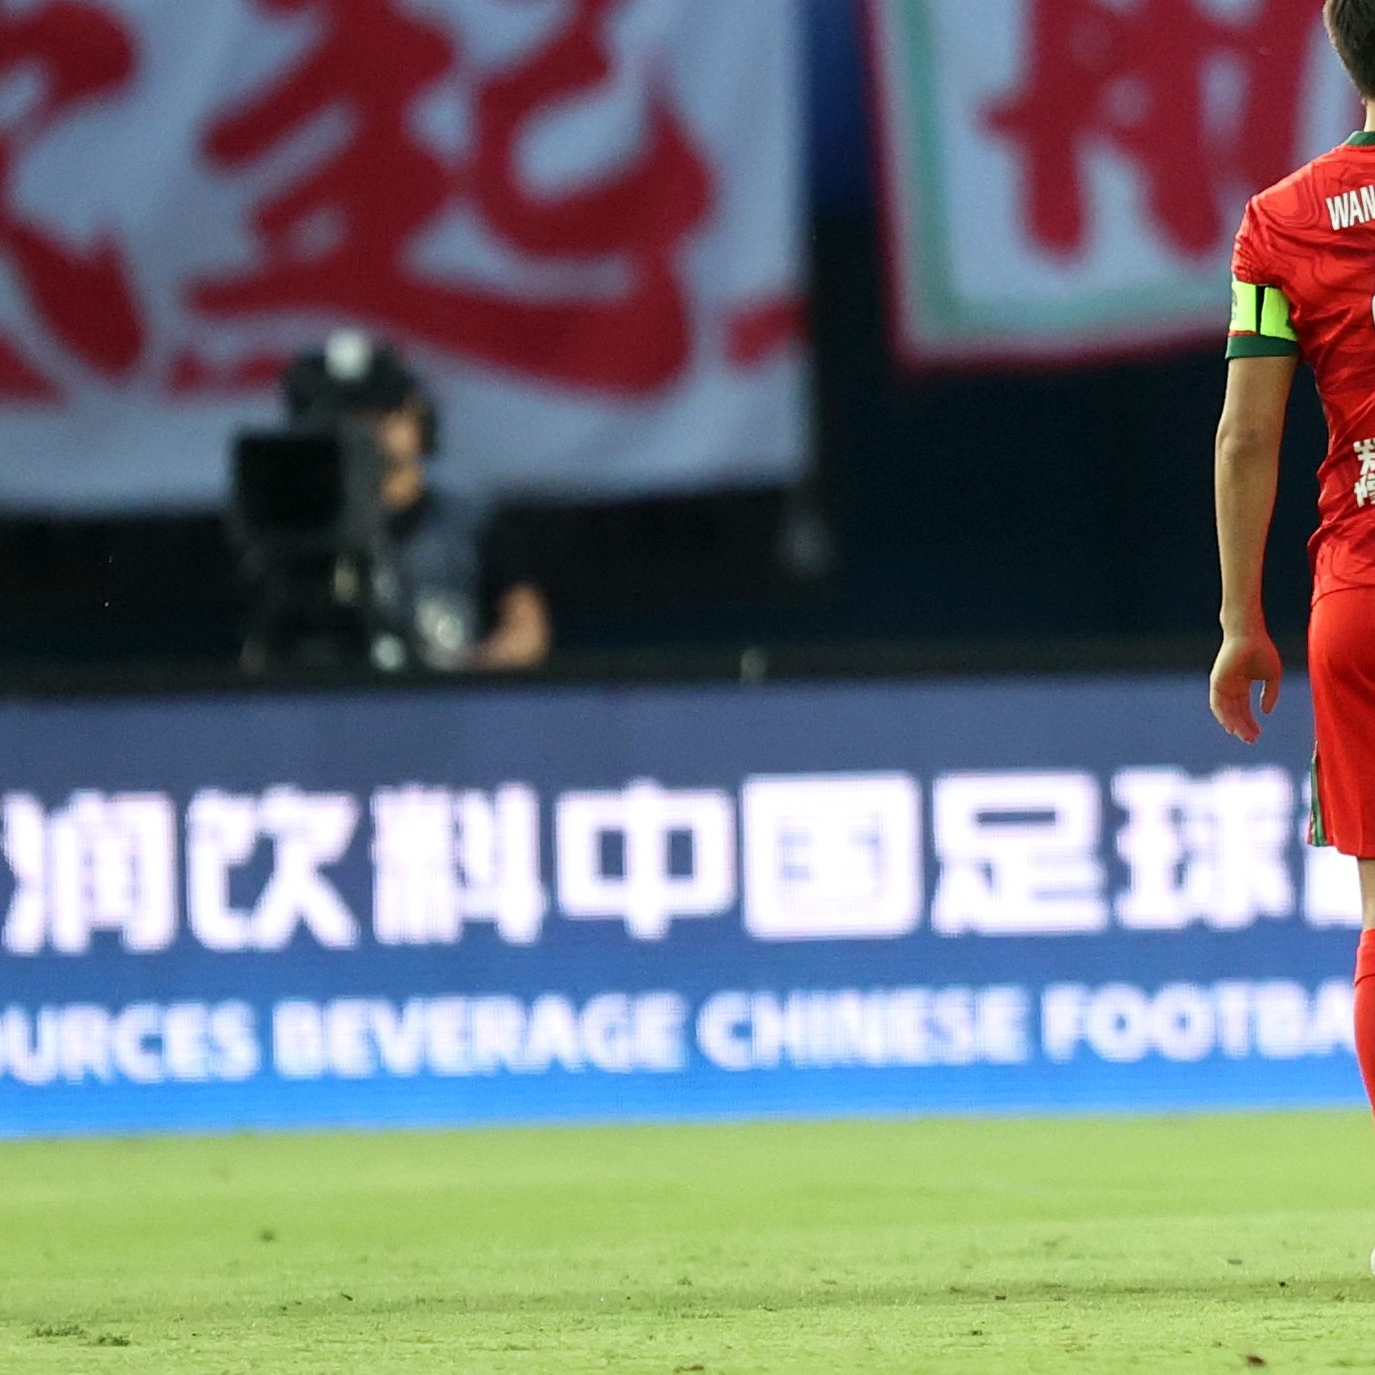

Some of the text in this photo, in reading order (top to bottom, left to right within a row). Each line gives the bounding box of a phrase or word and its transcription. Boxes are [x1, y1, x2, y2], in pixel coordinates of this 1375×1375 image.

[0, 999, 260, 1086] URCES
[271, 990, 689, 1080] BEVERAGE
[694, 980, 1030, 1072] CHINESE
[1040, 976, 1356, 1064] FOOTBA
